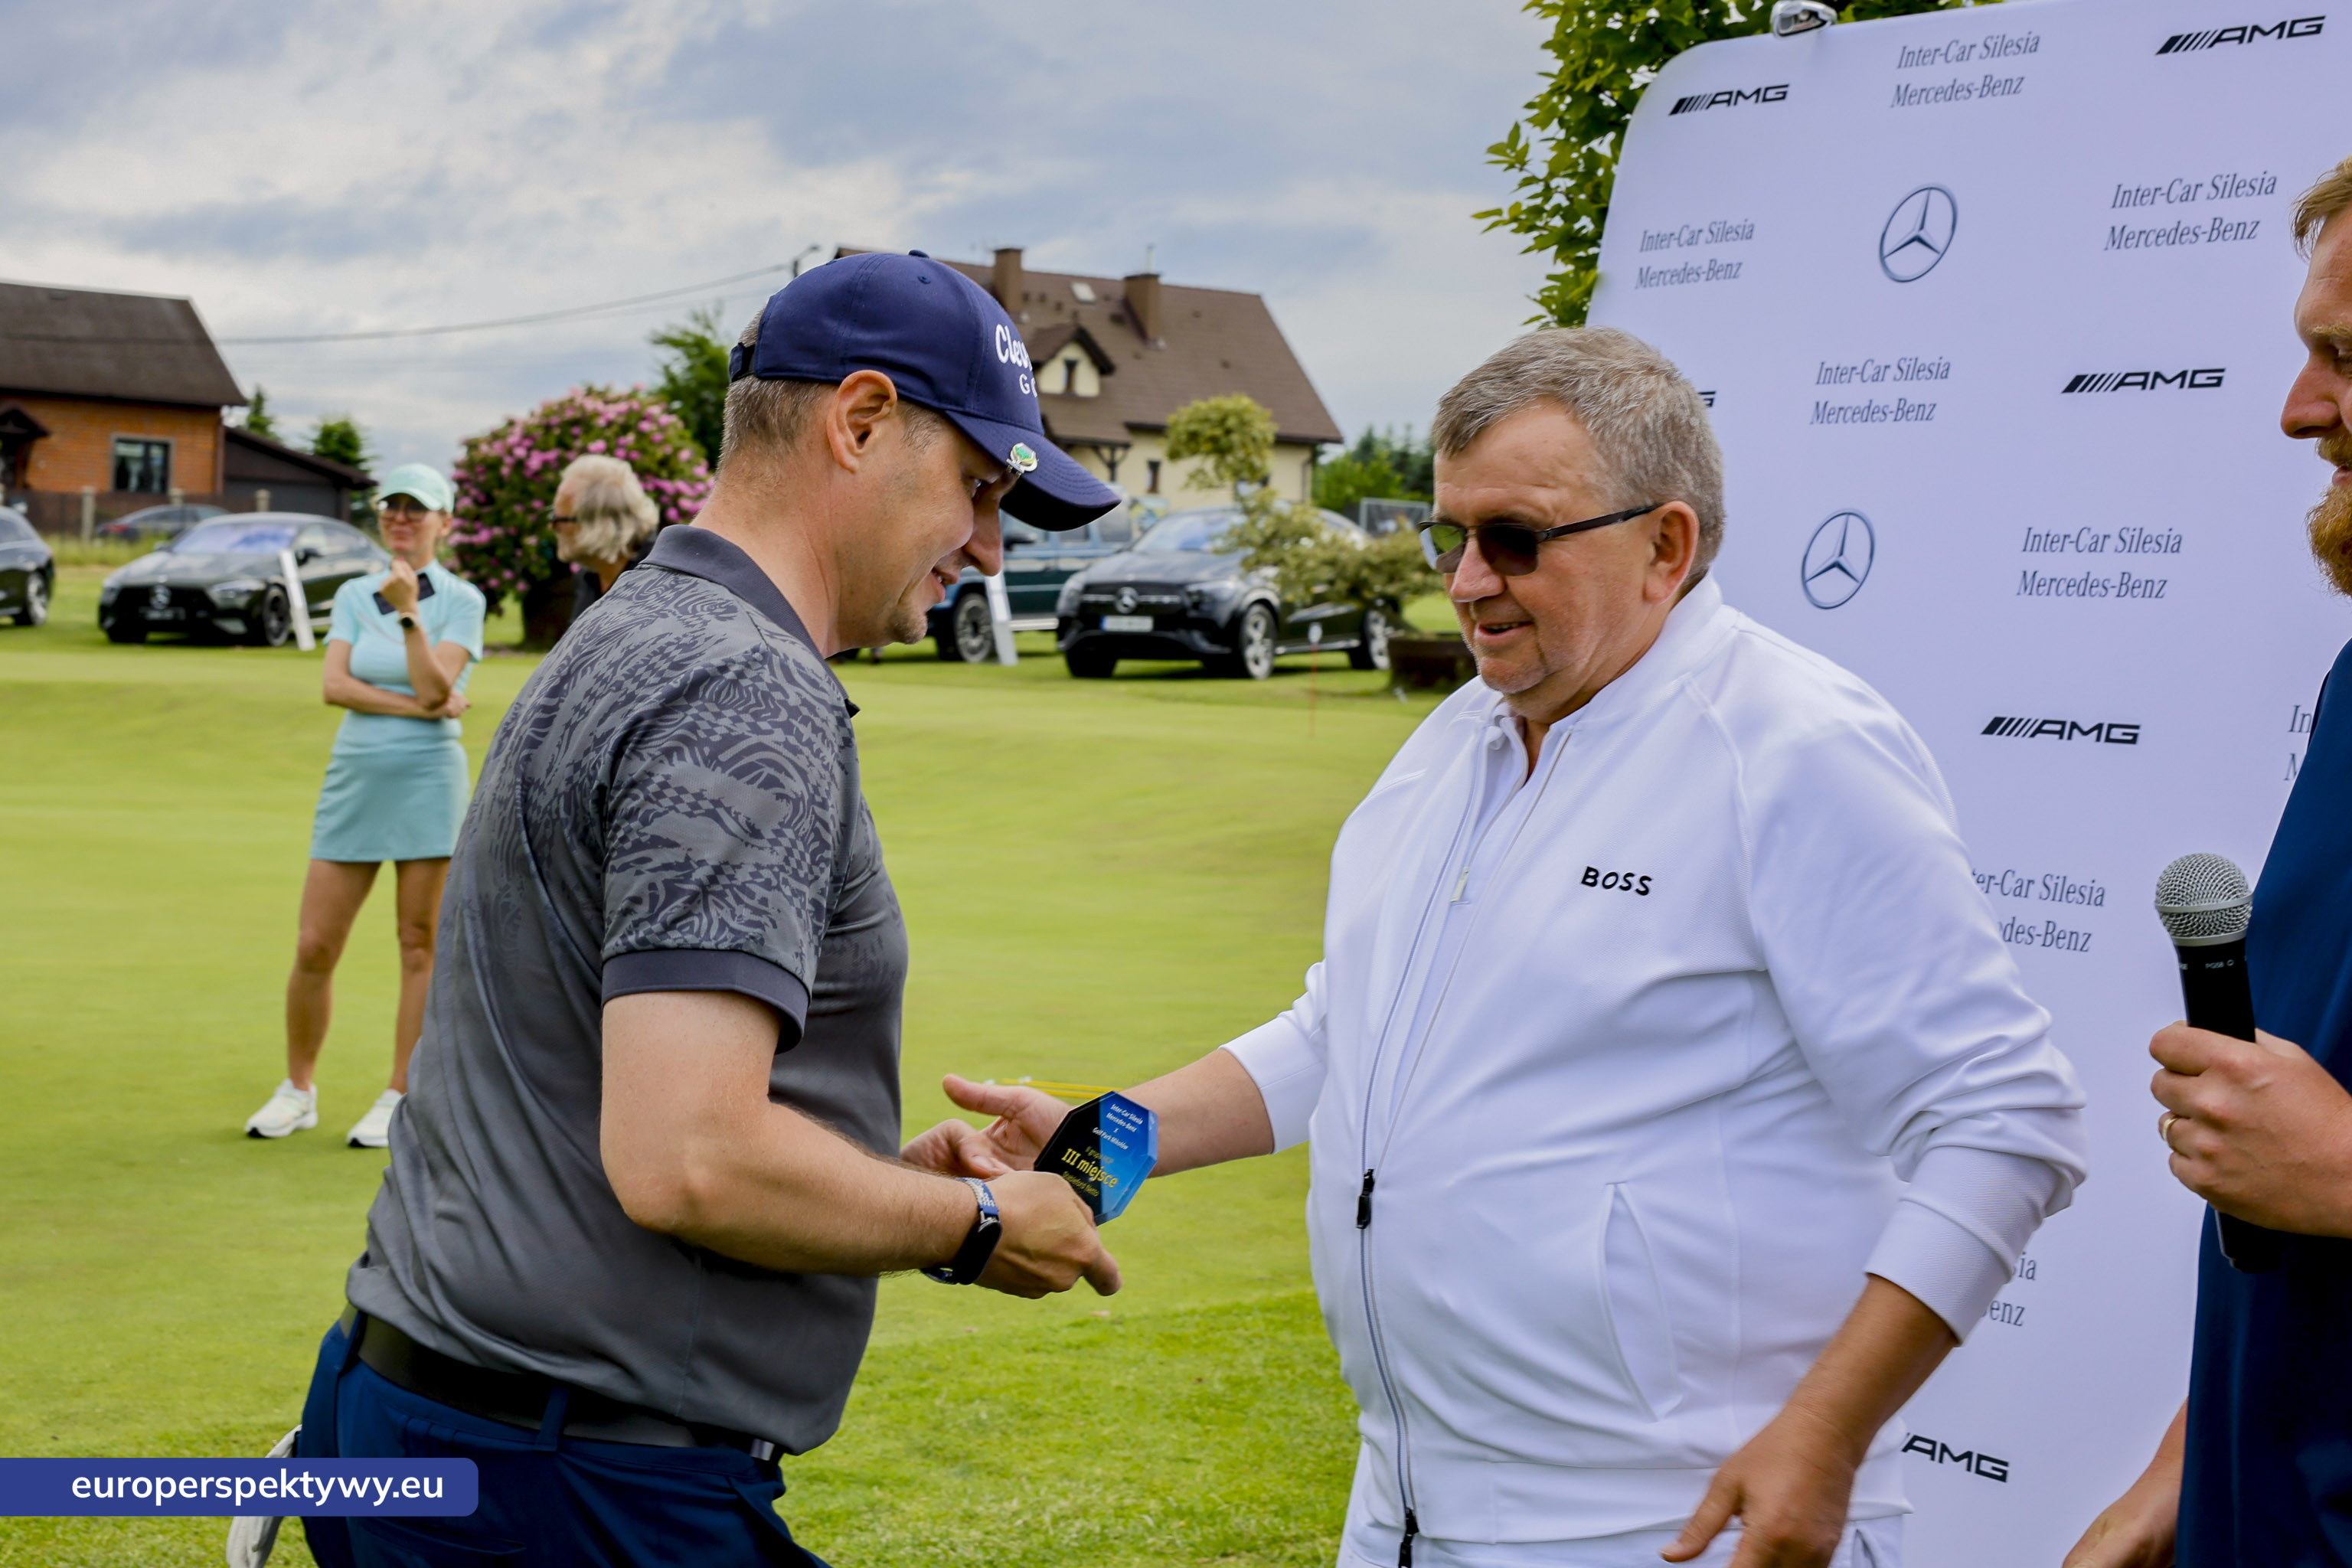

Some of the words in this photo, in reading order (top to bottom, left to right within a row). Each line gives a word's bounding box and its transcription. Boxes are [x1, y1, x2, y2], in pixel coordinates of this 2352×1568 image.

[2207, 16, 2325, 48] AMG
[1896, 39, 1976, 70] Inter-Car
[1978, 31, 2040, 60] Silesia
[1706, 85, 1788, 109] AMG
[1890, 74, 2026, 109] Mercedes-Benz
[2110, 178, 2203, 209] Inter-Car
[2207, 170, 2278, 200] Silesia
[1639, 224, 1704, 253] Inter-Car
[1705, 218, 1755, 244] Silesia
[2104, 217, 2261, 250] Mercedes-Benz
[1635, 258, 1743, 289] Mercedes-Benz
[1815, 358, 1891, 385] Inter-Car
[1893, 356, 1951, 381] Silesia
[2111, 368, 2225, 391] AMG
[1810, 397, 1937, 425] Mercedes-Benz
[2021, 526, 2111, 554] Inter-Car
[2114, 527, 2183, 554] Silesia
[2015, 570, 2168, 599] Mercedes-Benz
[2029, 719, 2140, 744] AMG
[1581, 866, 1652, 896] BOSS
[2039, 873, 2105, 906] Silesia
[1061, 1148, 1081, 1165] III
[1076, 1159, 1119, 1187] miejsce
[1902, 1434, 2008, 1482] AMG
